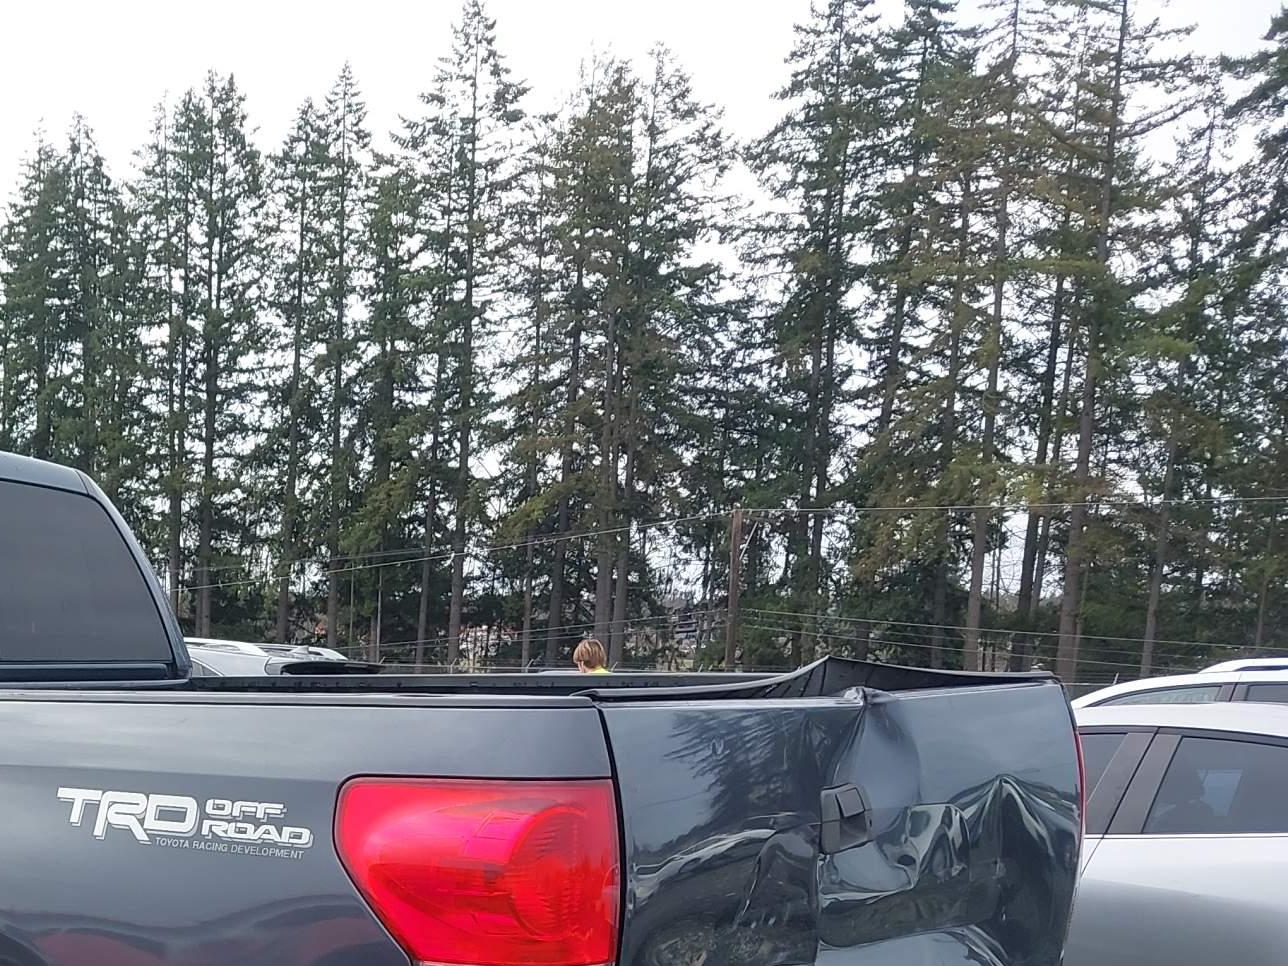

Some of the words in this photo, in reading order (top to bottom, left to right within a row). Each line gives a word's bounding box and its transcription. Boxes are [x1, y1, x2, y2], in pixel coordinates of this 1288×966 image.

[56, 786, 199, 844] TRD
[204, 797, 288, 822] OFF
[200, 818, 314, 848] ROAD
[155, 836, 191, 849] TOYOTA
[192, 840, 228, 854] RACING
[230, 843, 305, 861] DEVELOPMENT
